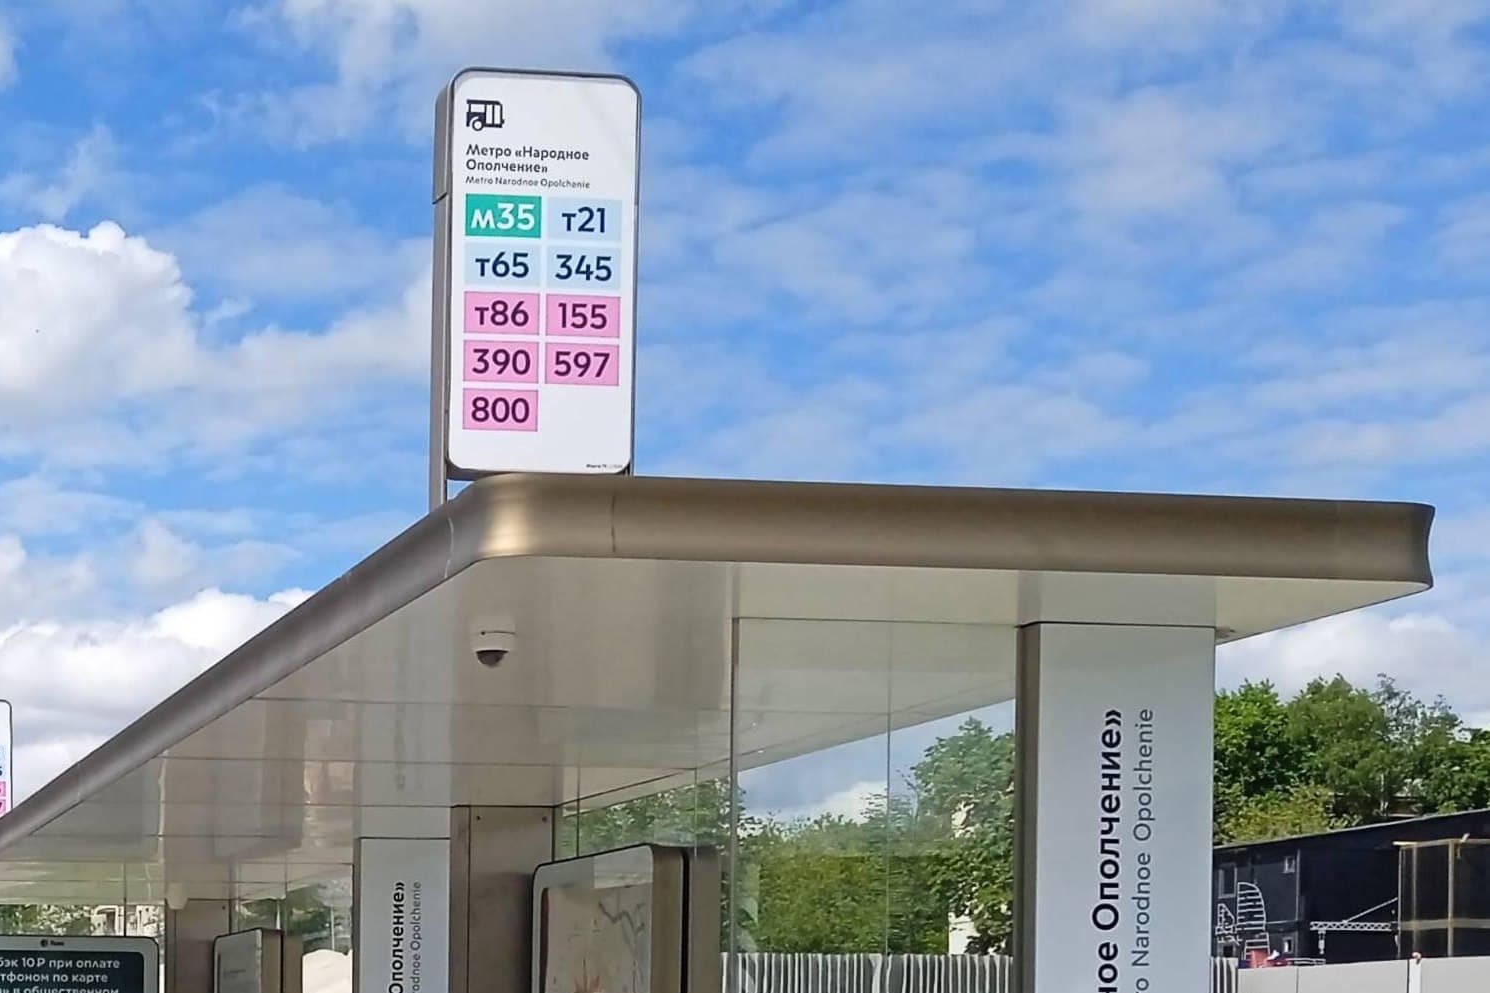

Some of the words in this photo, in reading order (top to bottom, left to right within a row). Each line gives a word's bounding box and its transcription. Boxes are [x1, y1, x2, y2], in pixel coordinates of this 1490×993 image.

[466, 143, 512, 160] Метро
[515, 146, 590, 162] «Народное
[466, 159, 548, 174] Ополчение»
[465, 176, 494, 187] Metro
[495, 177, 538, 188] Narodnoe
[540, 179, 591, 190] Opolchenie
[470, 203, 535, 231] м35
[562, 207, 606, 234] т21
[475, 252, 530, 279] т65
[555, 254, 612, 282] 345
[475, 300, 529, 327] т86
[558, 303, 608, 330] 155
[473, 348, 531, 375] 390
[554, 351, 610, 378] 597
[471, 397, 529, 423] 800
[1133, 708, 1156, 841] Opolchenie
[1092, 708, 1122, 932] Ополчение»
[410, 881, 423, 951] Opolchenie
[1131, 852, 1152, 967] Narodnoe
[48, 959, 73, 970] при
[76, 960, 120, 969] оплате
[53, 973, 69, 982] по
[71, 974, 109, 984] карте
